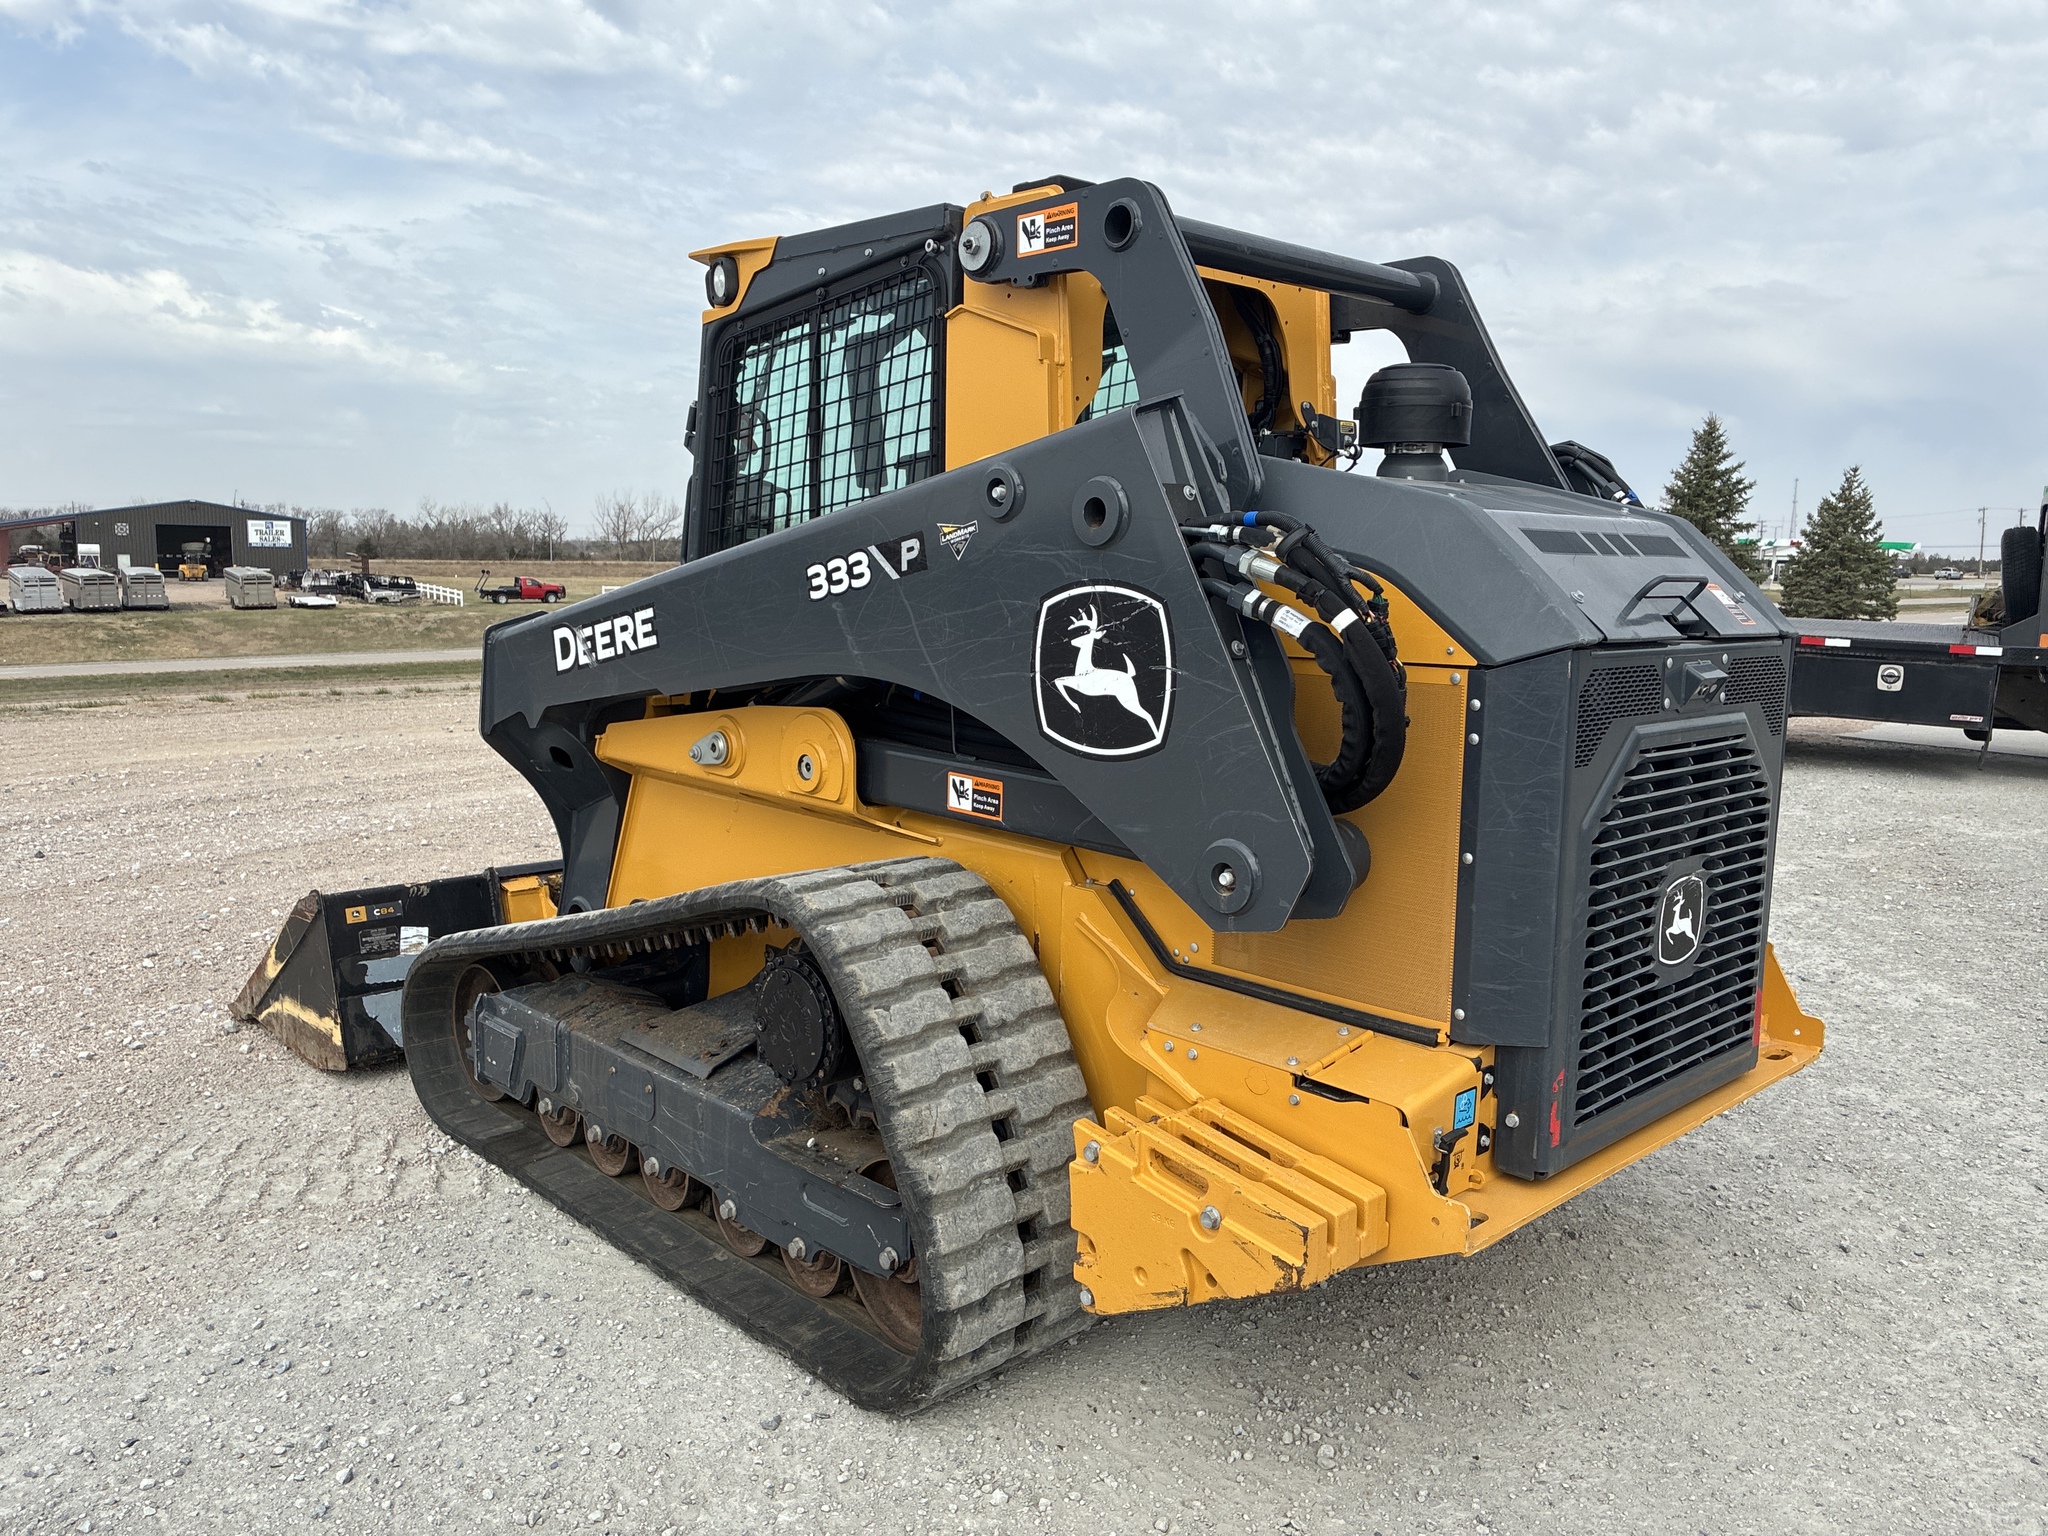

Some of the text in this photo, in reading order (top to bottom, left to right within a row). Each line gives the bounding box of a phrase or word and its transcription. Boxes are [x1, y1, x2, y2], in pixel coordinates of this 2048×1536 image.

[1051, 207, 1075, 218] WARNING
[1045, 224, 1074, 235] Pinch Area
[1045, 235, 1057, 244] Keep
[806, 551, 872, 600] 333
[553, 607, 658, 672] DEERE
[979, 781, 1000, 791] WARNING
[973, 793, 999, 805] Pinch Area
[973, 802, 995, 812] Keep Away
